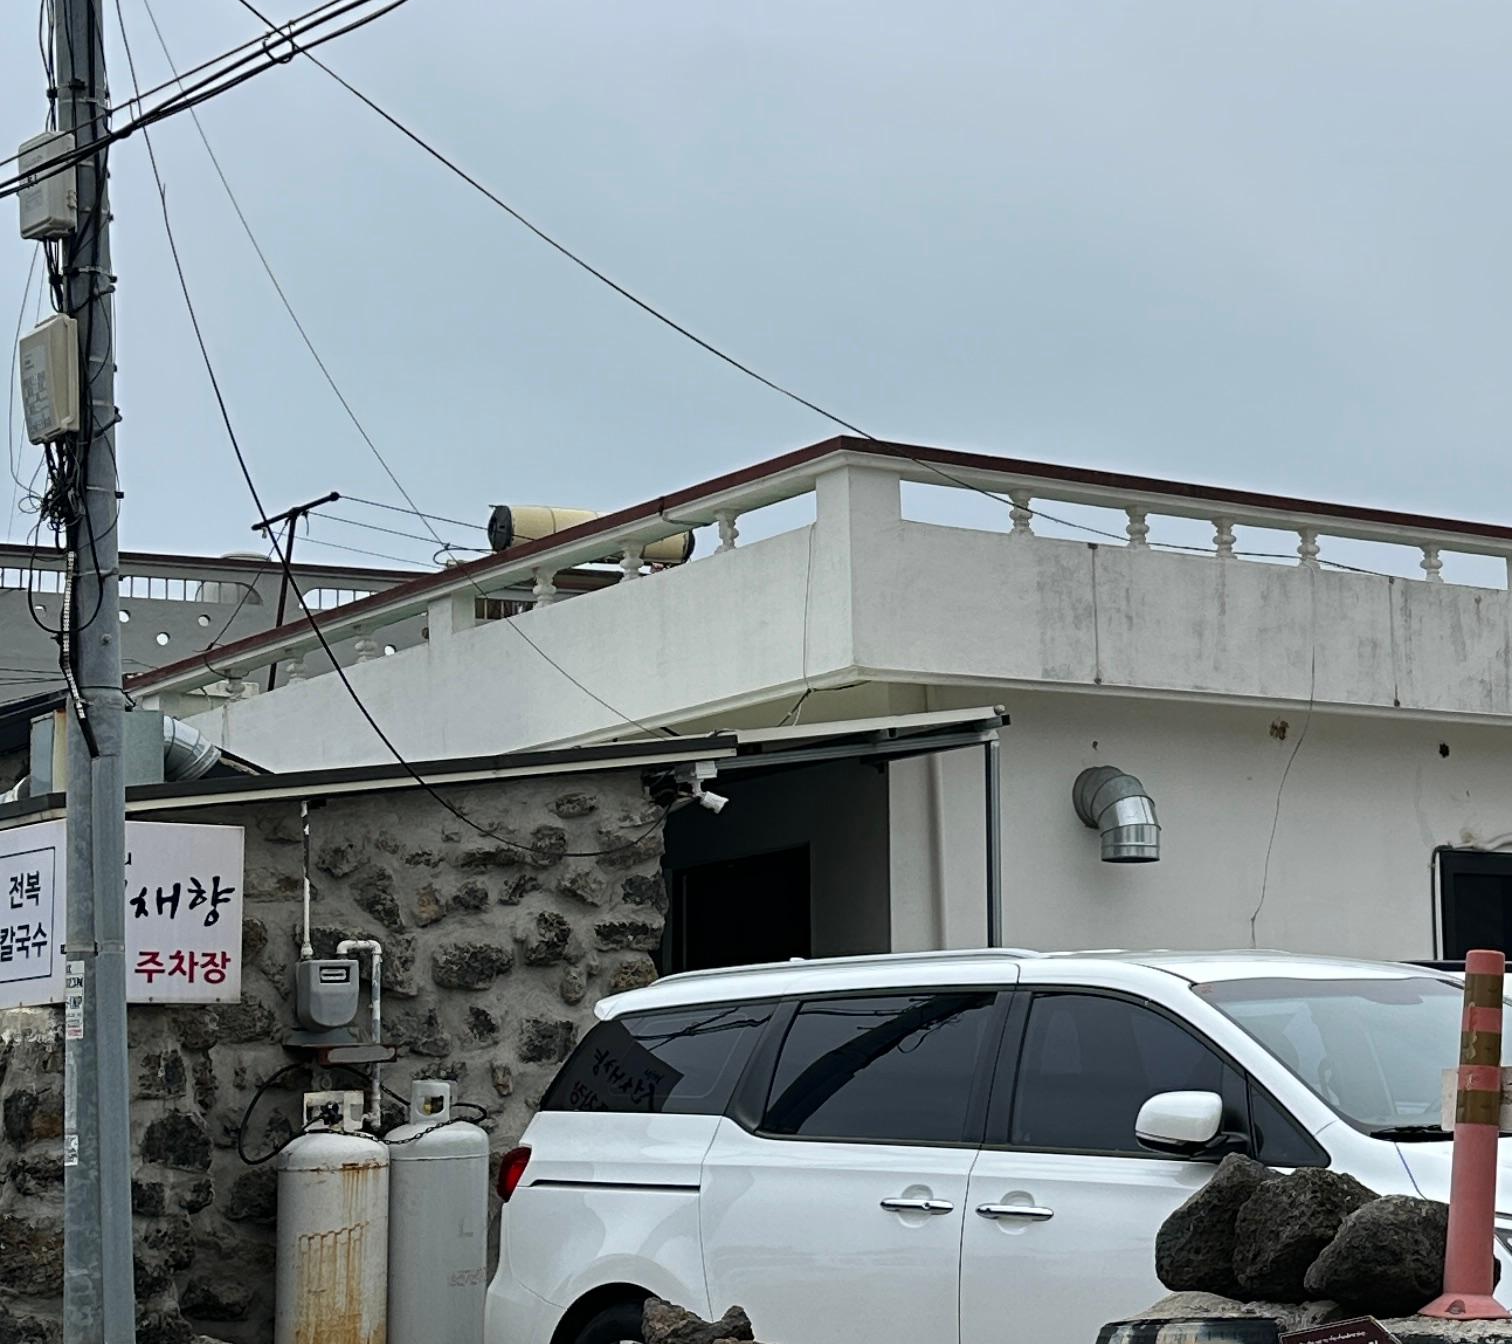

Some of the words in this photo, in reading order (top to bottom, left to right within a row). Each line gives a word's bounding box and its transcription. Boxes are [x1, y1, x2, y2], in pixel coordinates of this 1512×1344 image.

[9, 870, 41, 909] 전복
[125, 875, 235, 927] 채향
[0, 922, 48, 962] 칼국수
[134, 950, 231, 984] 주차장
